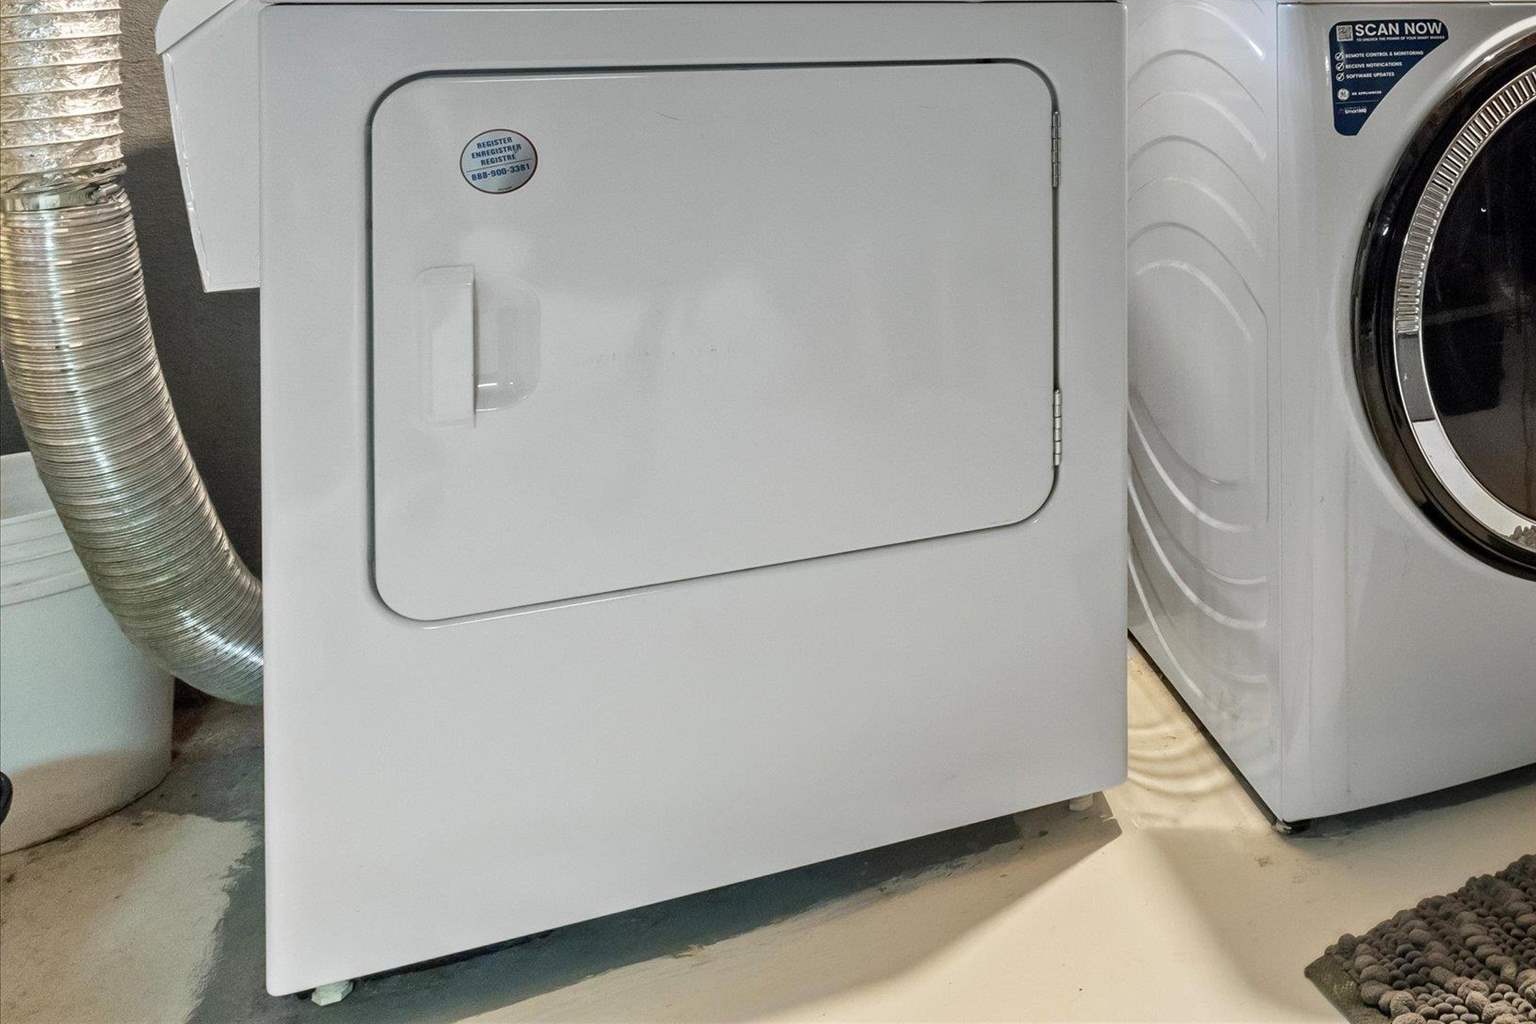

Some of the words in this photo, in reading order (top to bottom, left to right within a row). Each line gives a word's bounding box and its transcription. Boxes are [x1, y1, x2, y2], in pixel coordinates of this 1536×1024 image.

[1355, 22, 1400, 37] SCAN
[1404, 22, 1442, 35] NOW
[476, 136, 513, 149] REGISTER
[471, 144, 522, 159] ENREGISTRER
[480, 154, 516, 166] REGISTRE
